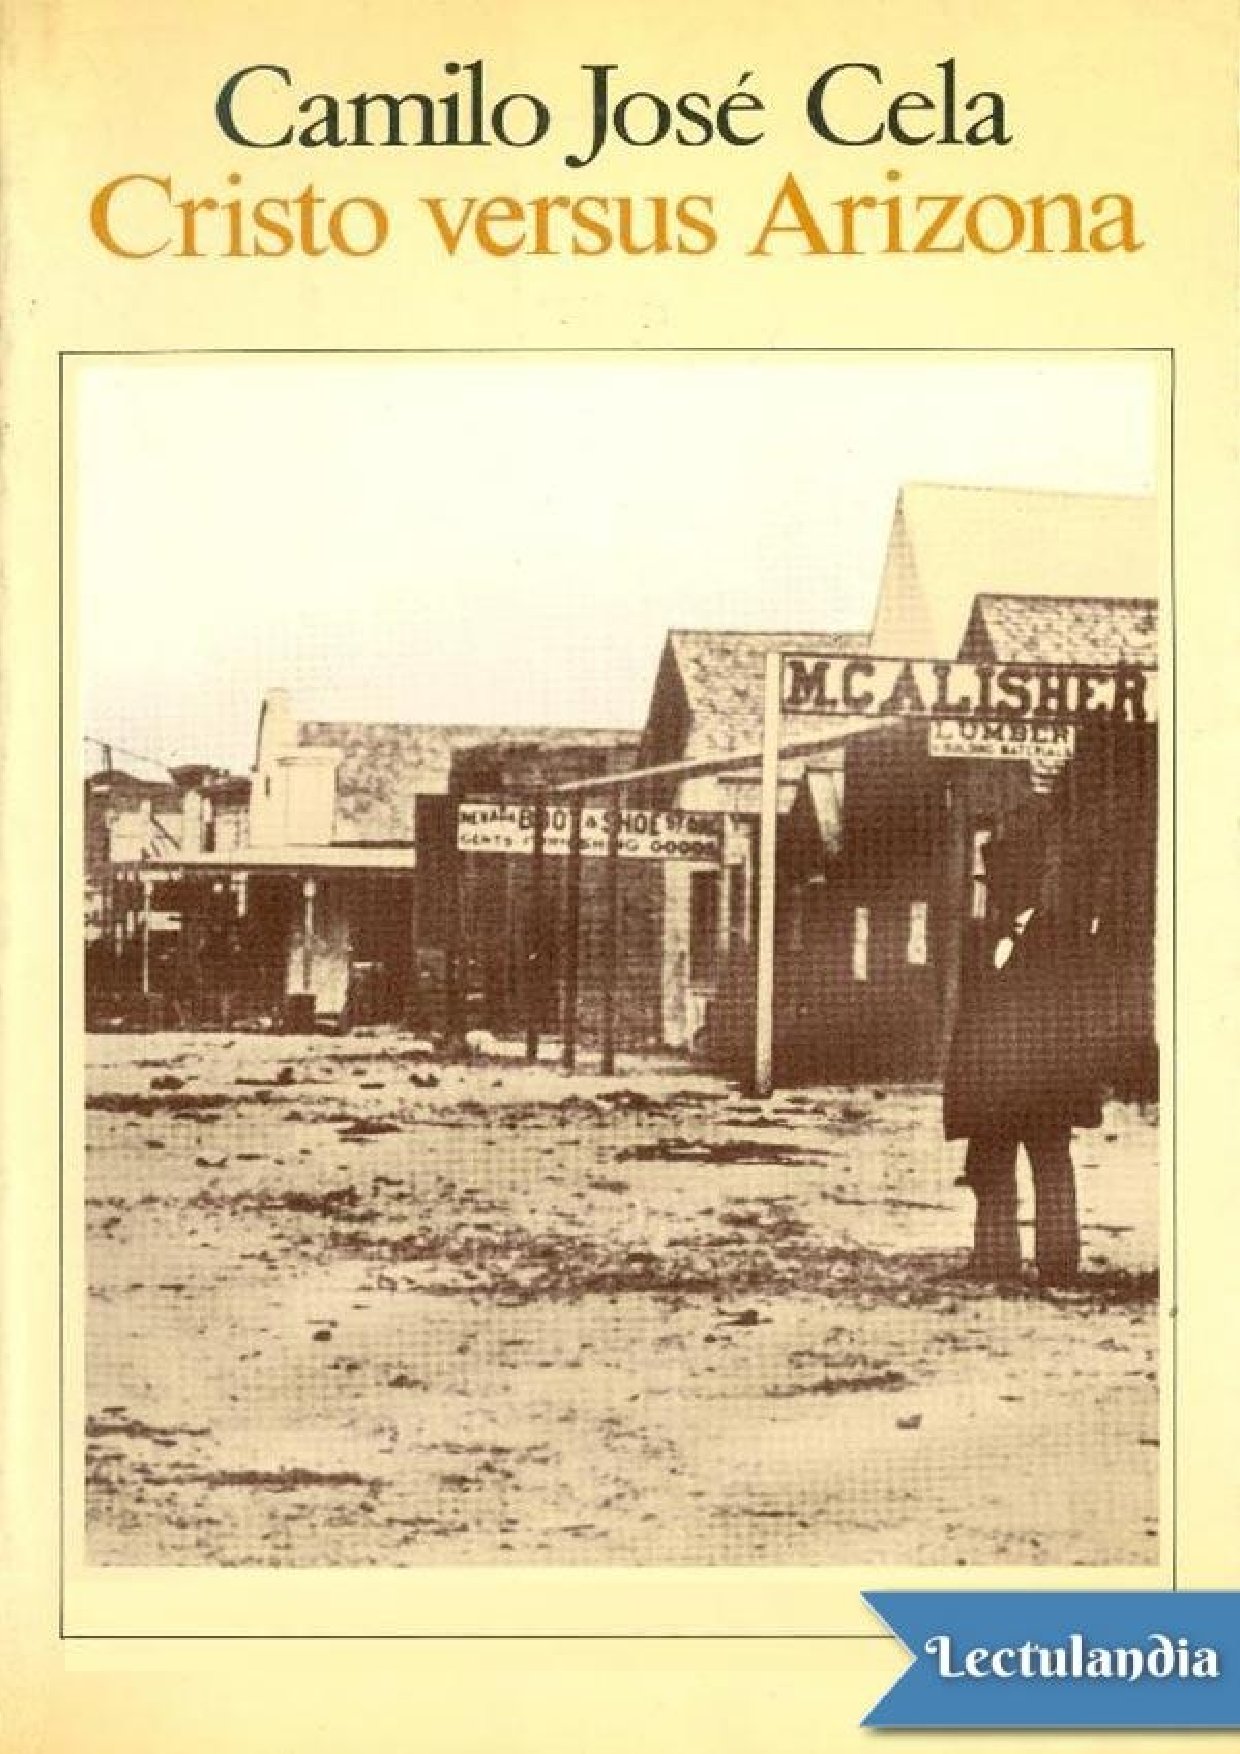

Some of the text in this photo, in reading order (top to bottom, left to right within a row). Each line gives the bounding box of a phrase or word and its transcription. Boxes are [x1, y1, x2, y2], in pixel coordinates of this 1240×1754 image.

[215, 58, 1013, 169] Camilo José Cela
[89, 169, 1144, 258] Cristo versus Arizona
[935, 719, 1071, 744] LUMBER
